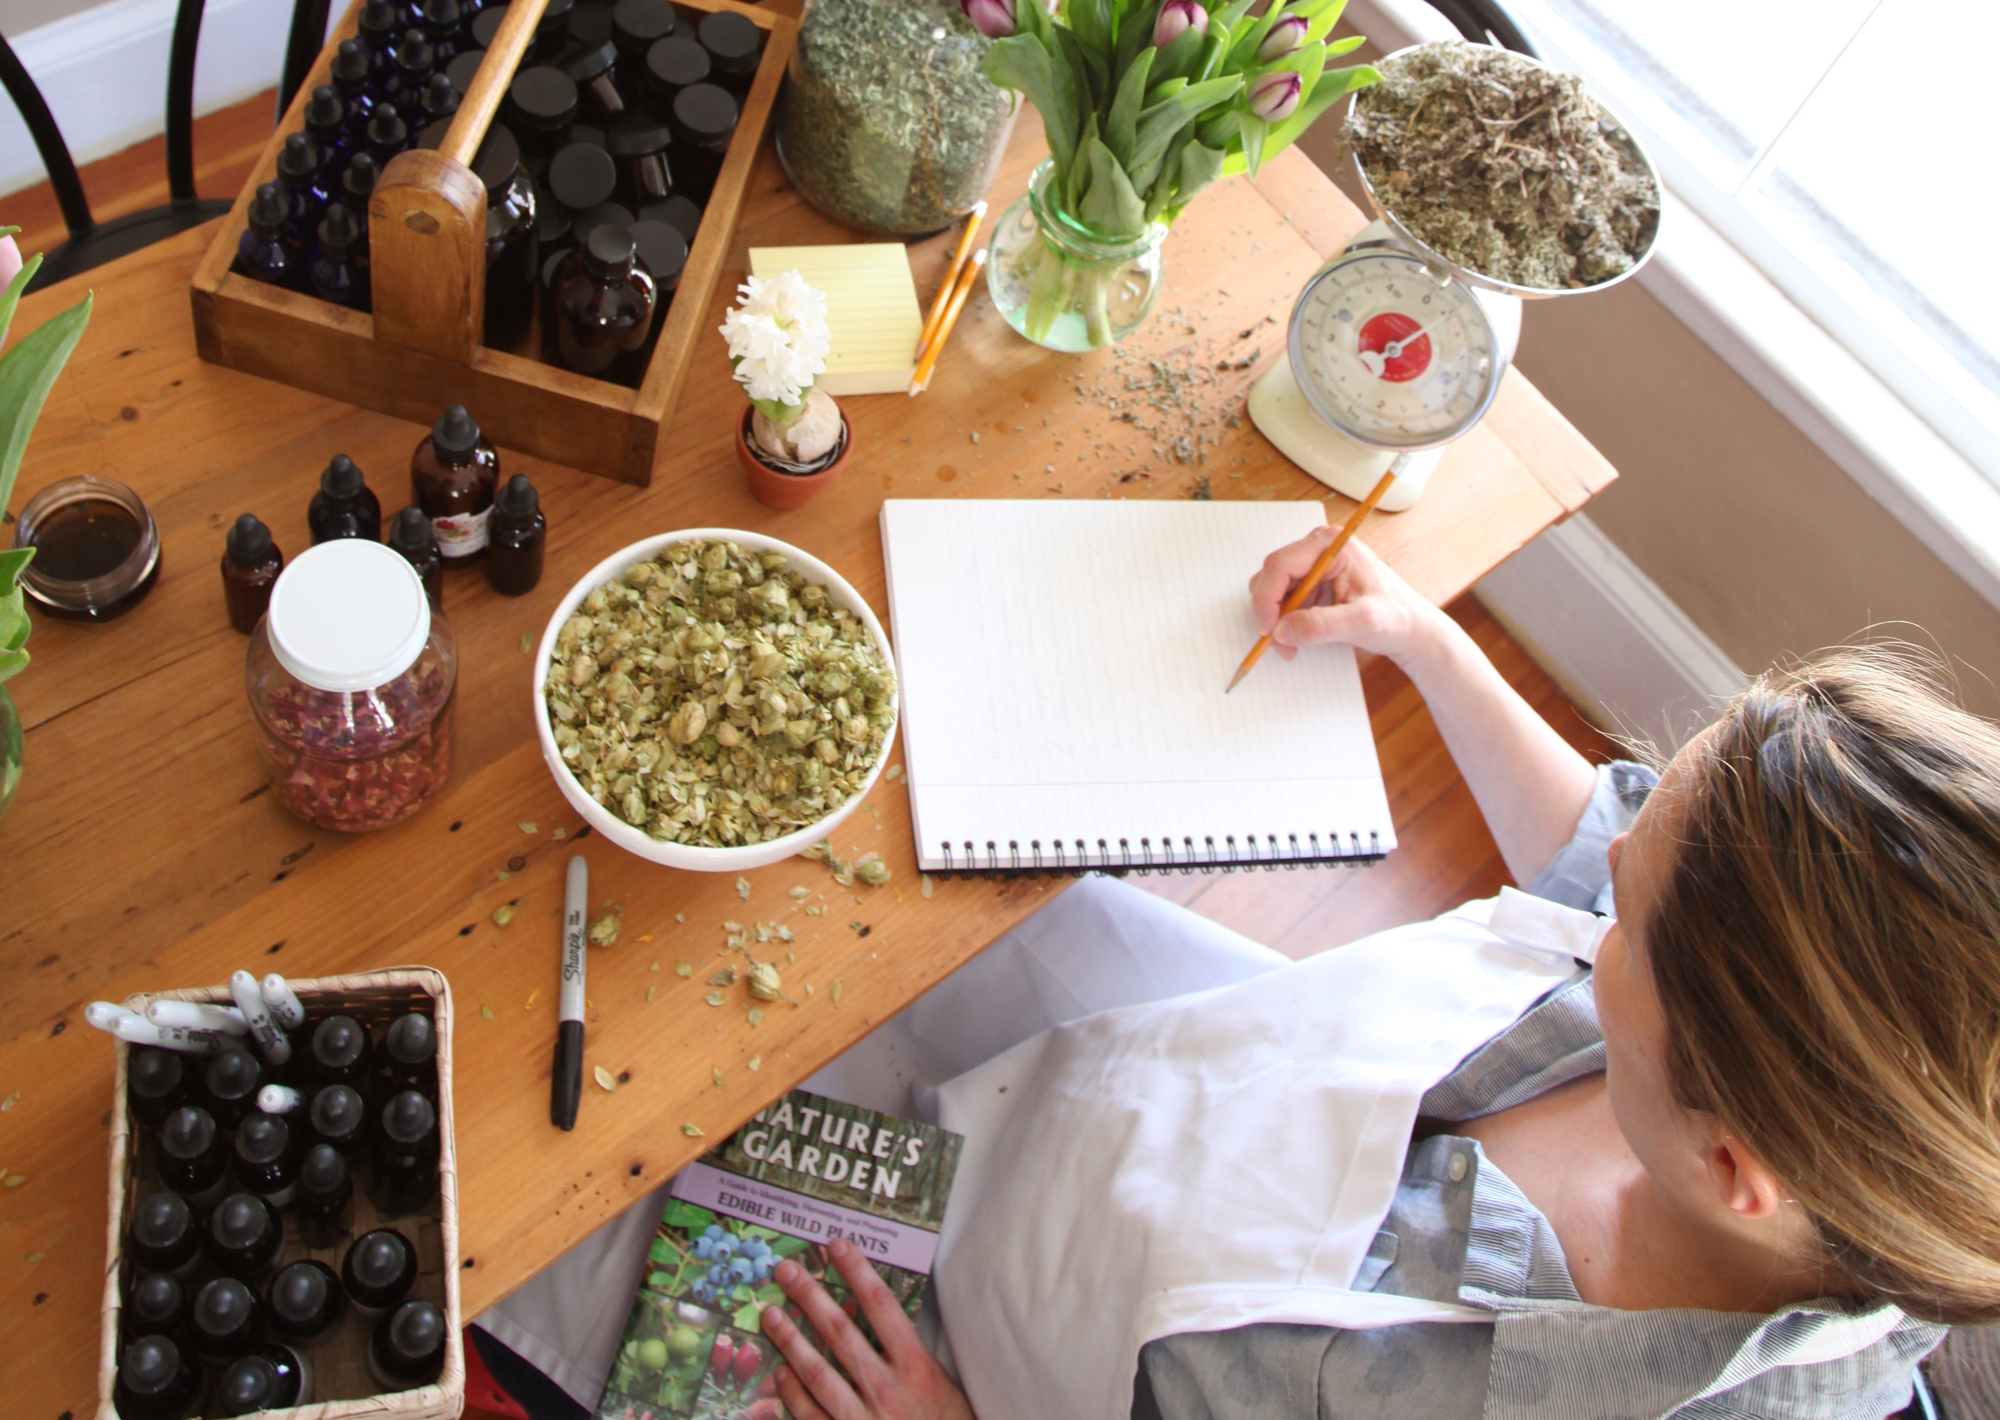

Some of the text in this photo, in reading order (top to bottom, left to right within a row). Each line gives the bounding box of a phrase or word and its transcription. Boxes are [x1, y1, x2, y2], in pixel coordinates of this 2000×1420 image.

[564, 931, 582, 984] Sharpie
[742, 1130, 902, 1200] GARDEN
[717, 1191, 777, 1221] EDIBLE
[781, 1210, 822, 1235] WILD
